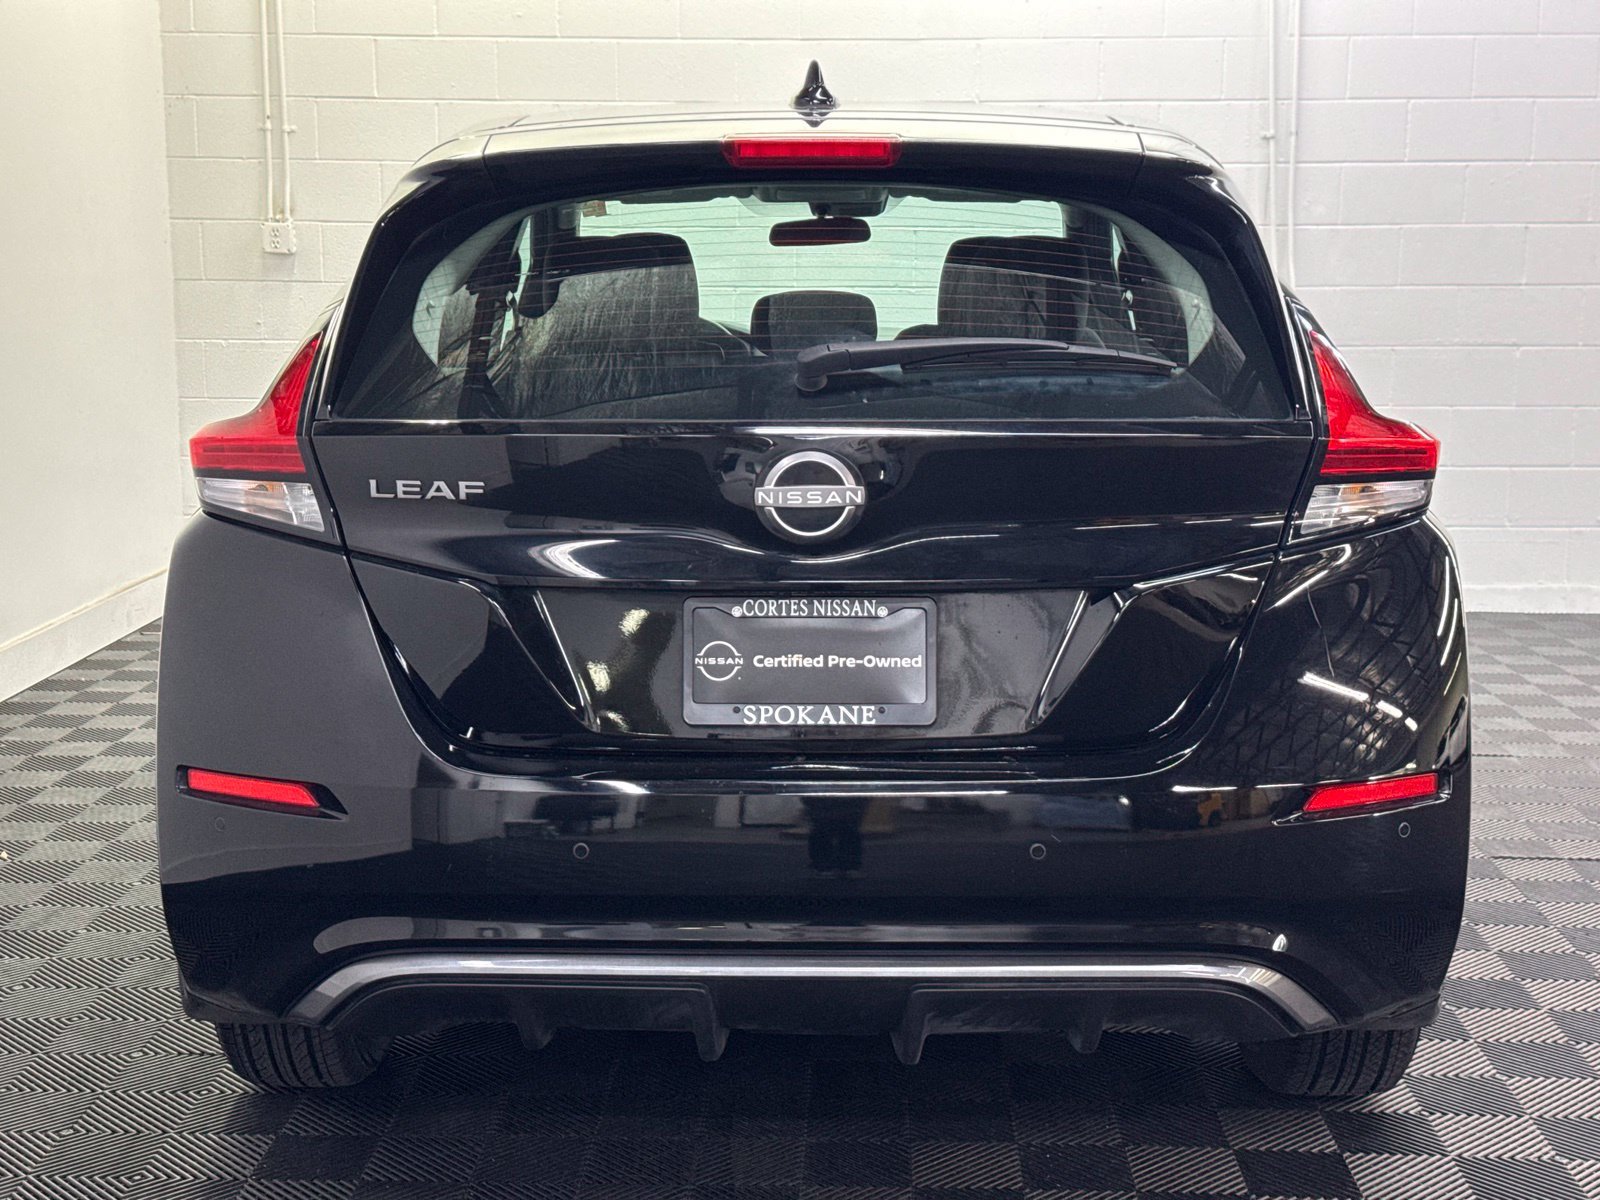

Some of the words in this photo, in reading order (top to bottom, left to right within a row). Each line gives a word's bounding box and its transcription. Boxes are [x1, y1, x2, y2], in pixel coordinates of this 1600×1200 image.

[369, 479, 485, 500] LEAF
[758, 490, 863, 504] NISSAN
[743, 599, 808, 617] CORTES
[813, 599, 876, 617] NISSAN
[695, 657, 743, 665] NISSAN
[753, 654, 824, 668] Certified
[828, 654, 922, 668] Pre-Owned
[743, 705, 876, 725] SPOKANE
